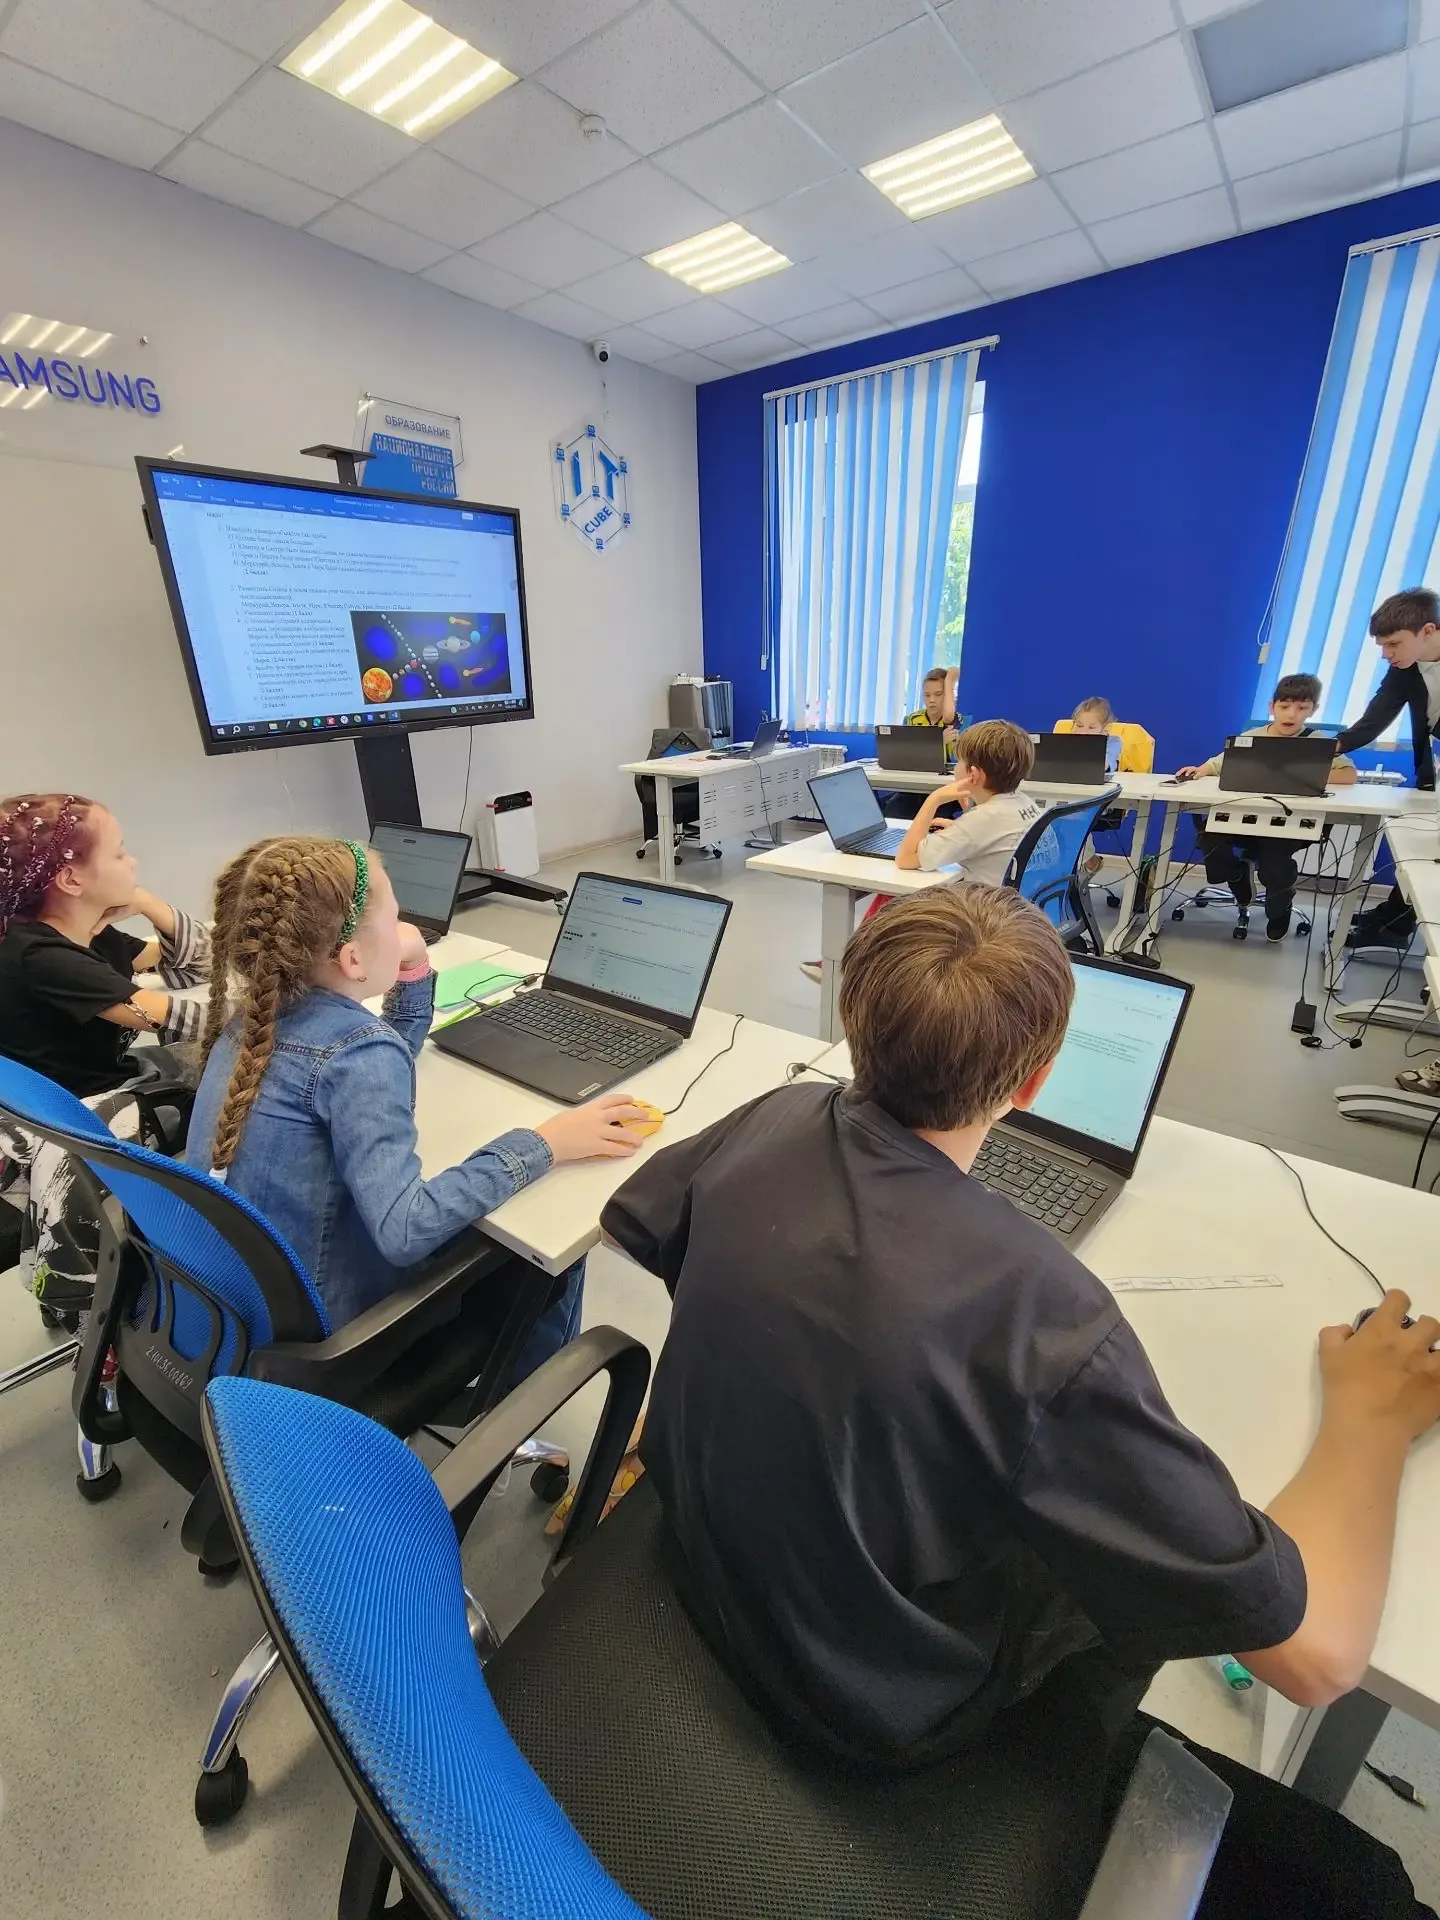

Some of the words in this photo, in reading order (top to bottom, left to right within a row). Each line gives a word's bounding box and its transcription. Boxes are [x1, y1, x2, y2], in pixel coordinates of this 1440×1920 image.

[384, 414, 452, 439] ОБРАЗОВАНИЕ
[375, 434, 453, 465] НАЦИОНАЛЬНЫЕ
[411, 458, 454, 480] ПРОЕКТЫ
[584, 505, 613, 534] CUBE
